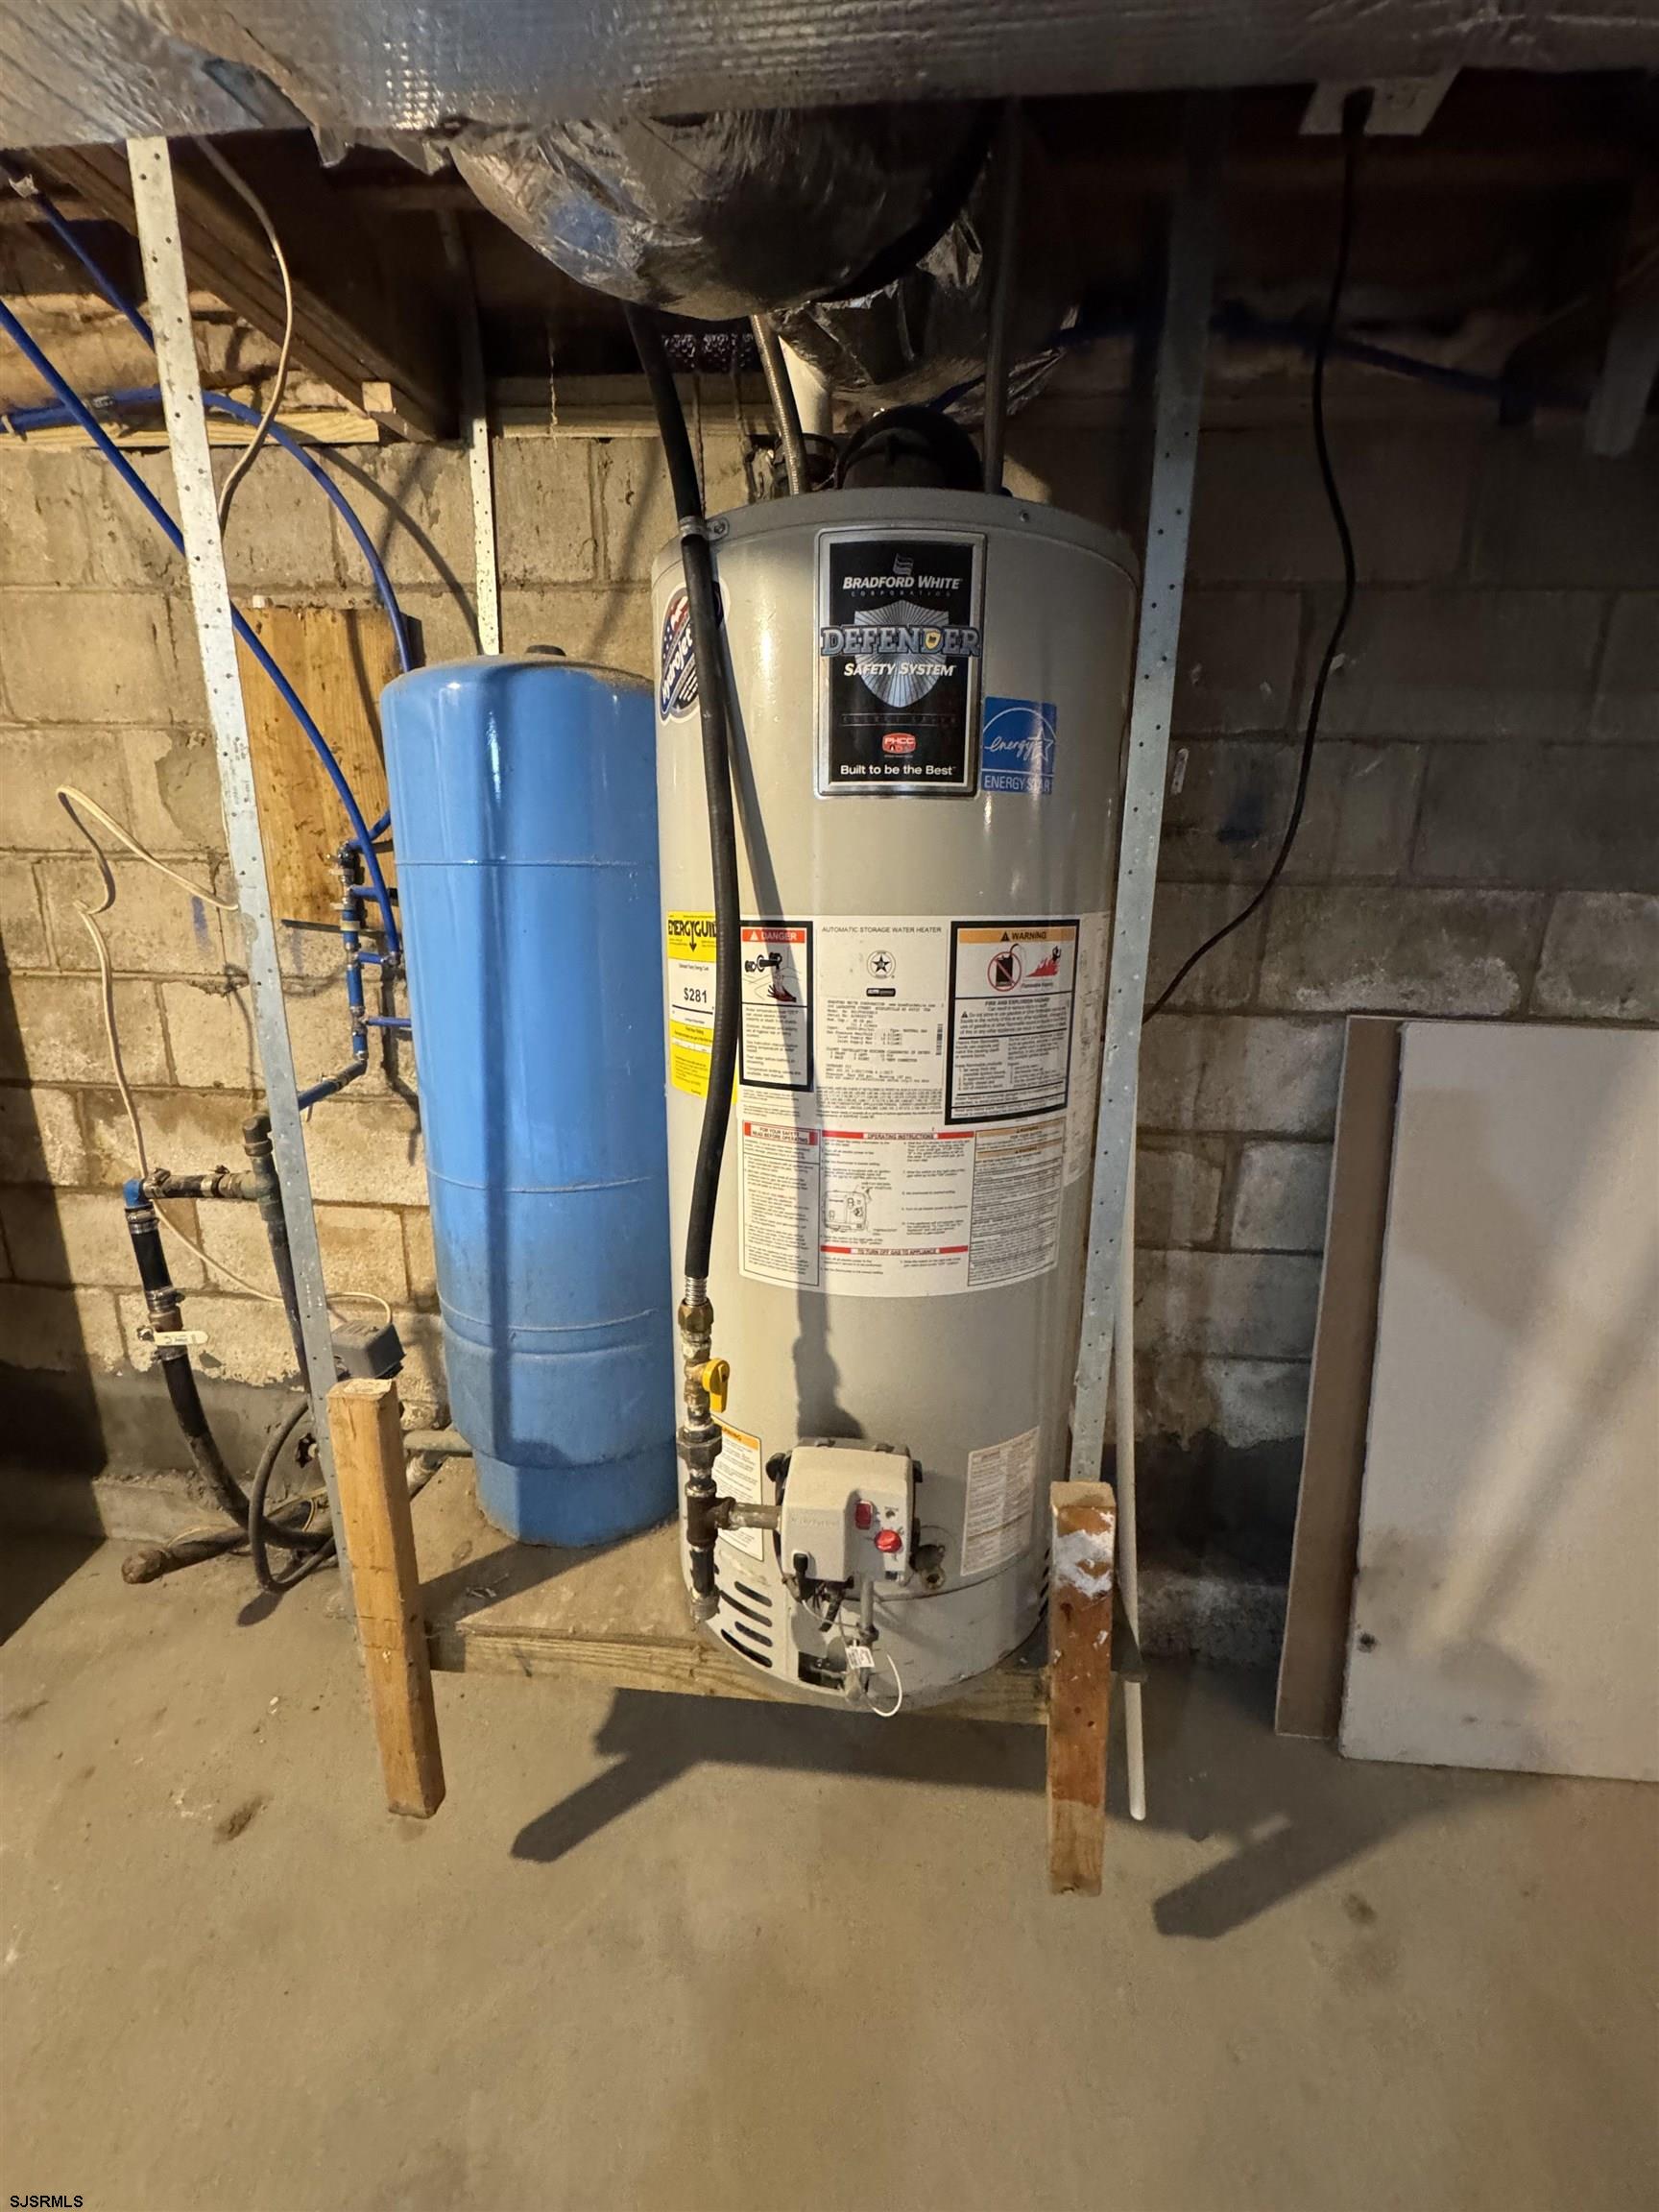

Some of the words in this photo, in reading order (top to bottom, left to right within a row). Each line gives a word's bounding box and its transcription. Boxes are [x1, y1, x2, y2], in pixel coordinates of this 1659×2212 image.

[843, 576, 915, 589] BRADFORD
[918, 576, 960, 589] WHITE
[821, 625, 980, 656] DEFENDER
[844, 662, 896, 676] SAFETY
[899, 662, 954, 677] SYSTEM
[840, 764, 866, 775] Built
[869, 766, 881, 775] to
[884, 764, 900, 775] be
[902, 764, 923, 775] the
[926, 765, 953, 776] Best
[984, 775, 1026, 790] ENERGY
[760, 930, 797, 941] DANGER
[1011, 931, 1046, 940] WARNING
